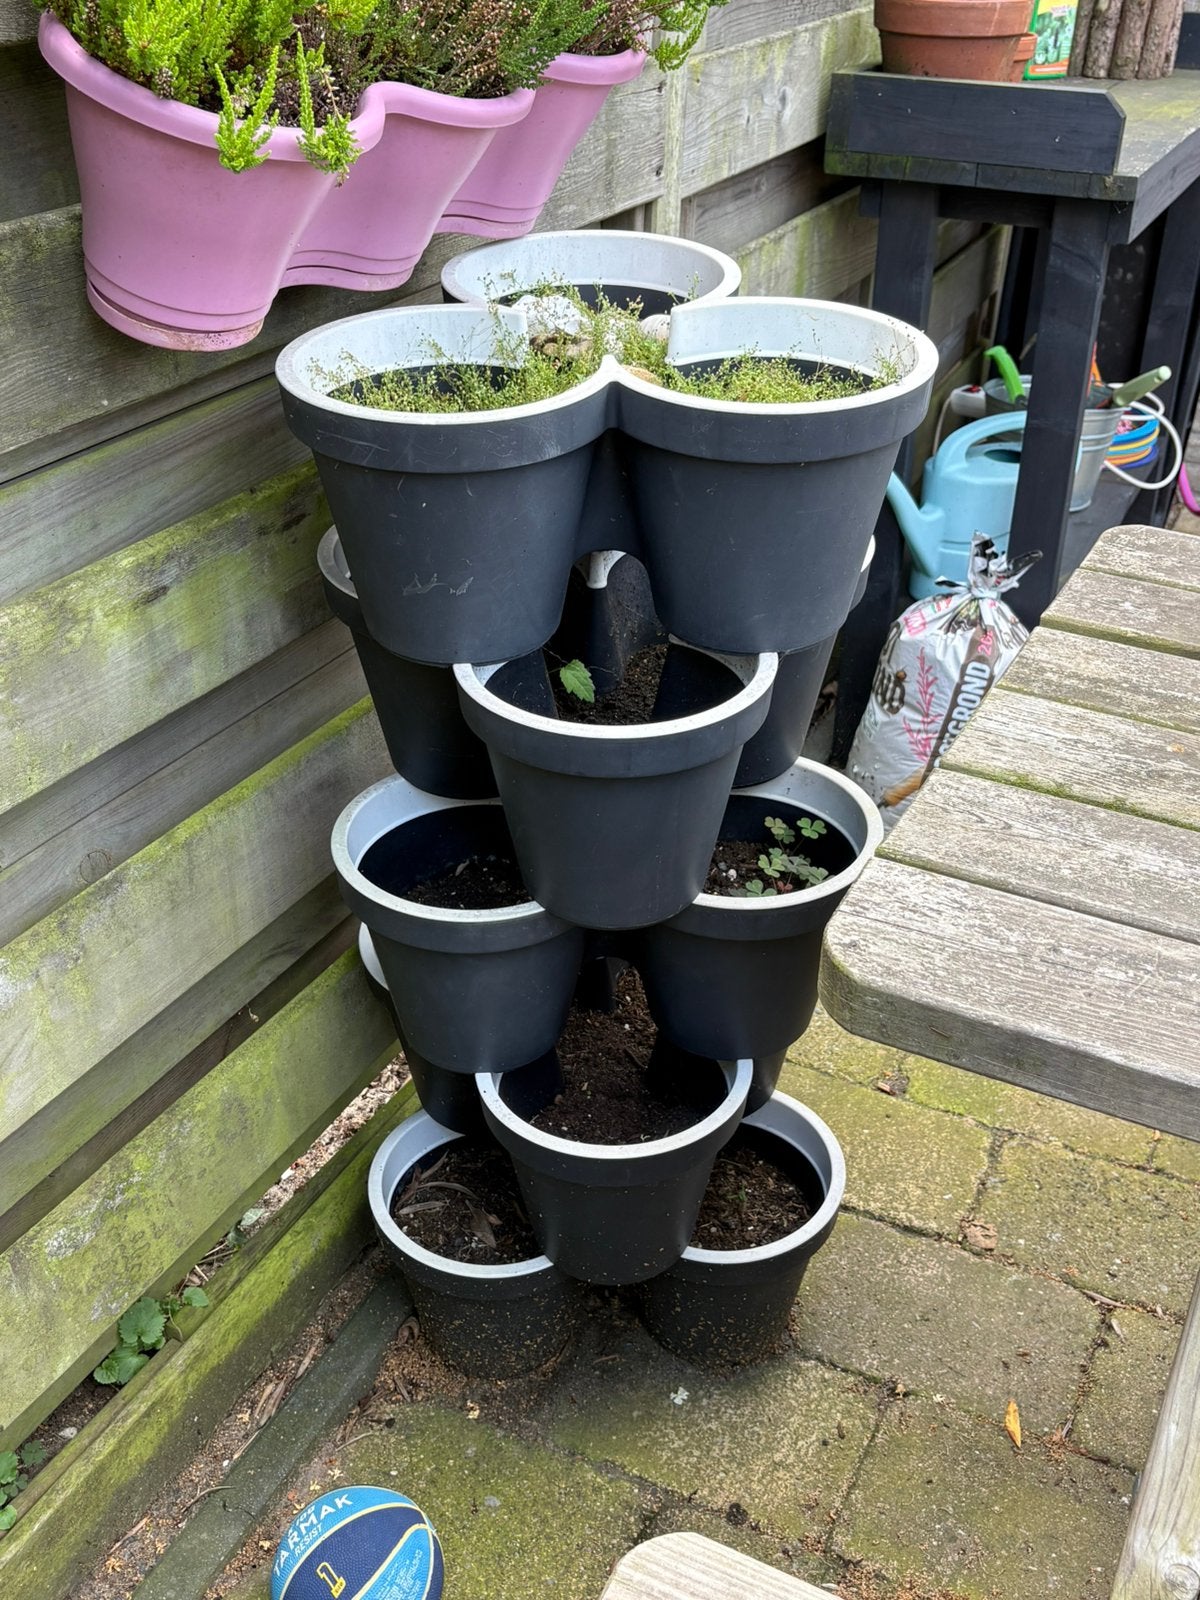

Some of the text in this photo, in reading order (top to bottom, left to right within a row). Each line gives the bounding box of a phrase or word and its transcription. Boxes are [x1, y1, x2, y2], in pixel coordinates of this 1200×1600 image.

[934, 660, 992, 768] GROND
[273, 1493, 354, 1577] TARMAK
[294, 1523, 322, 1557] RESIST
[316, 1561, 347, 1599] 1
